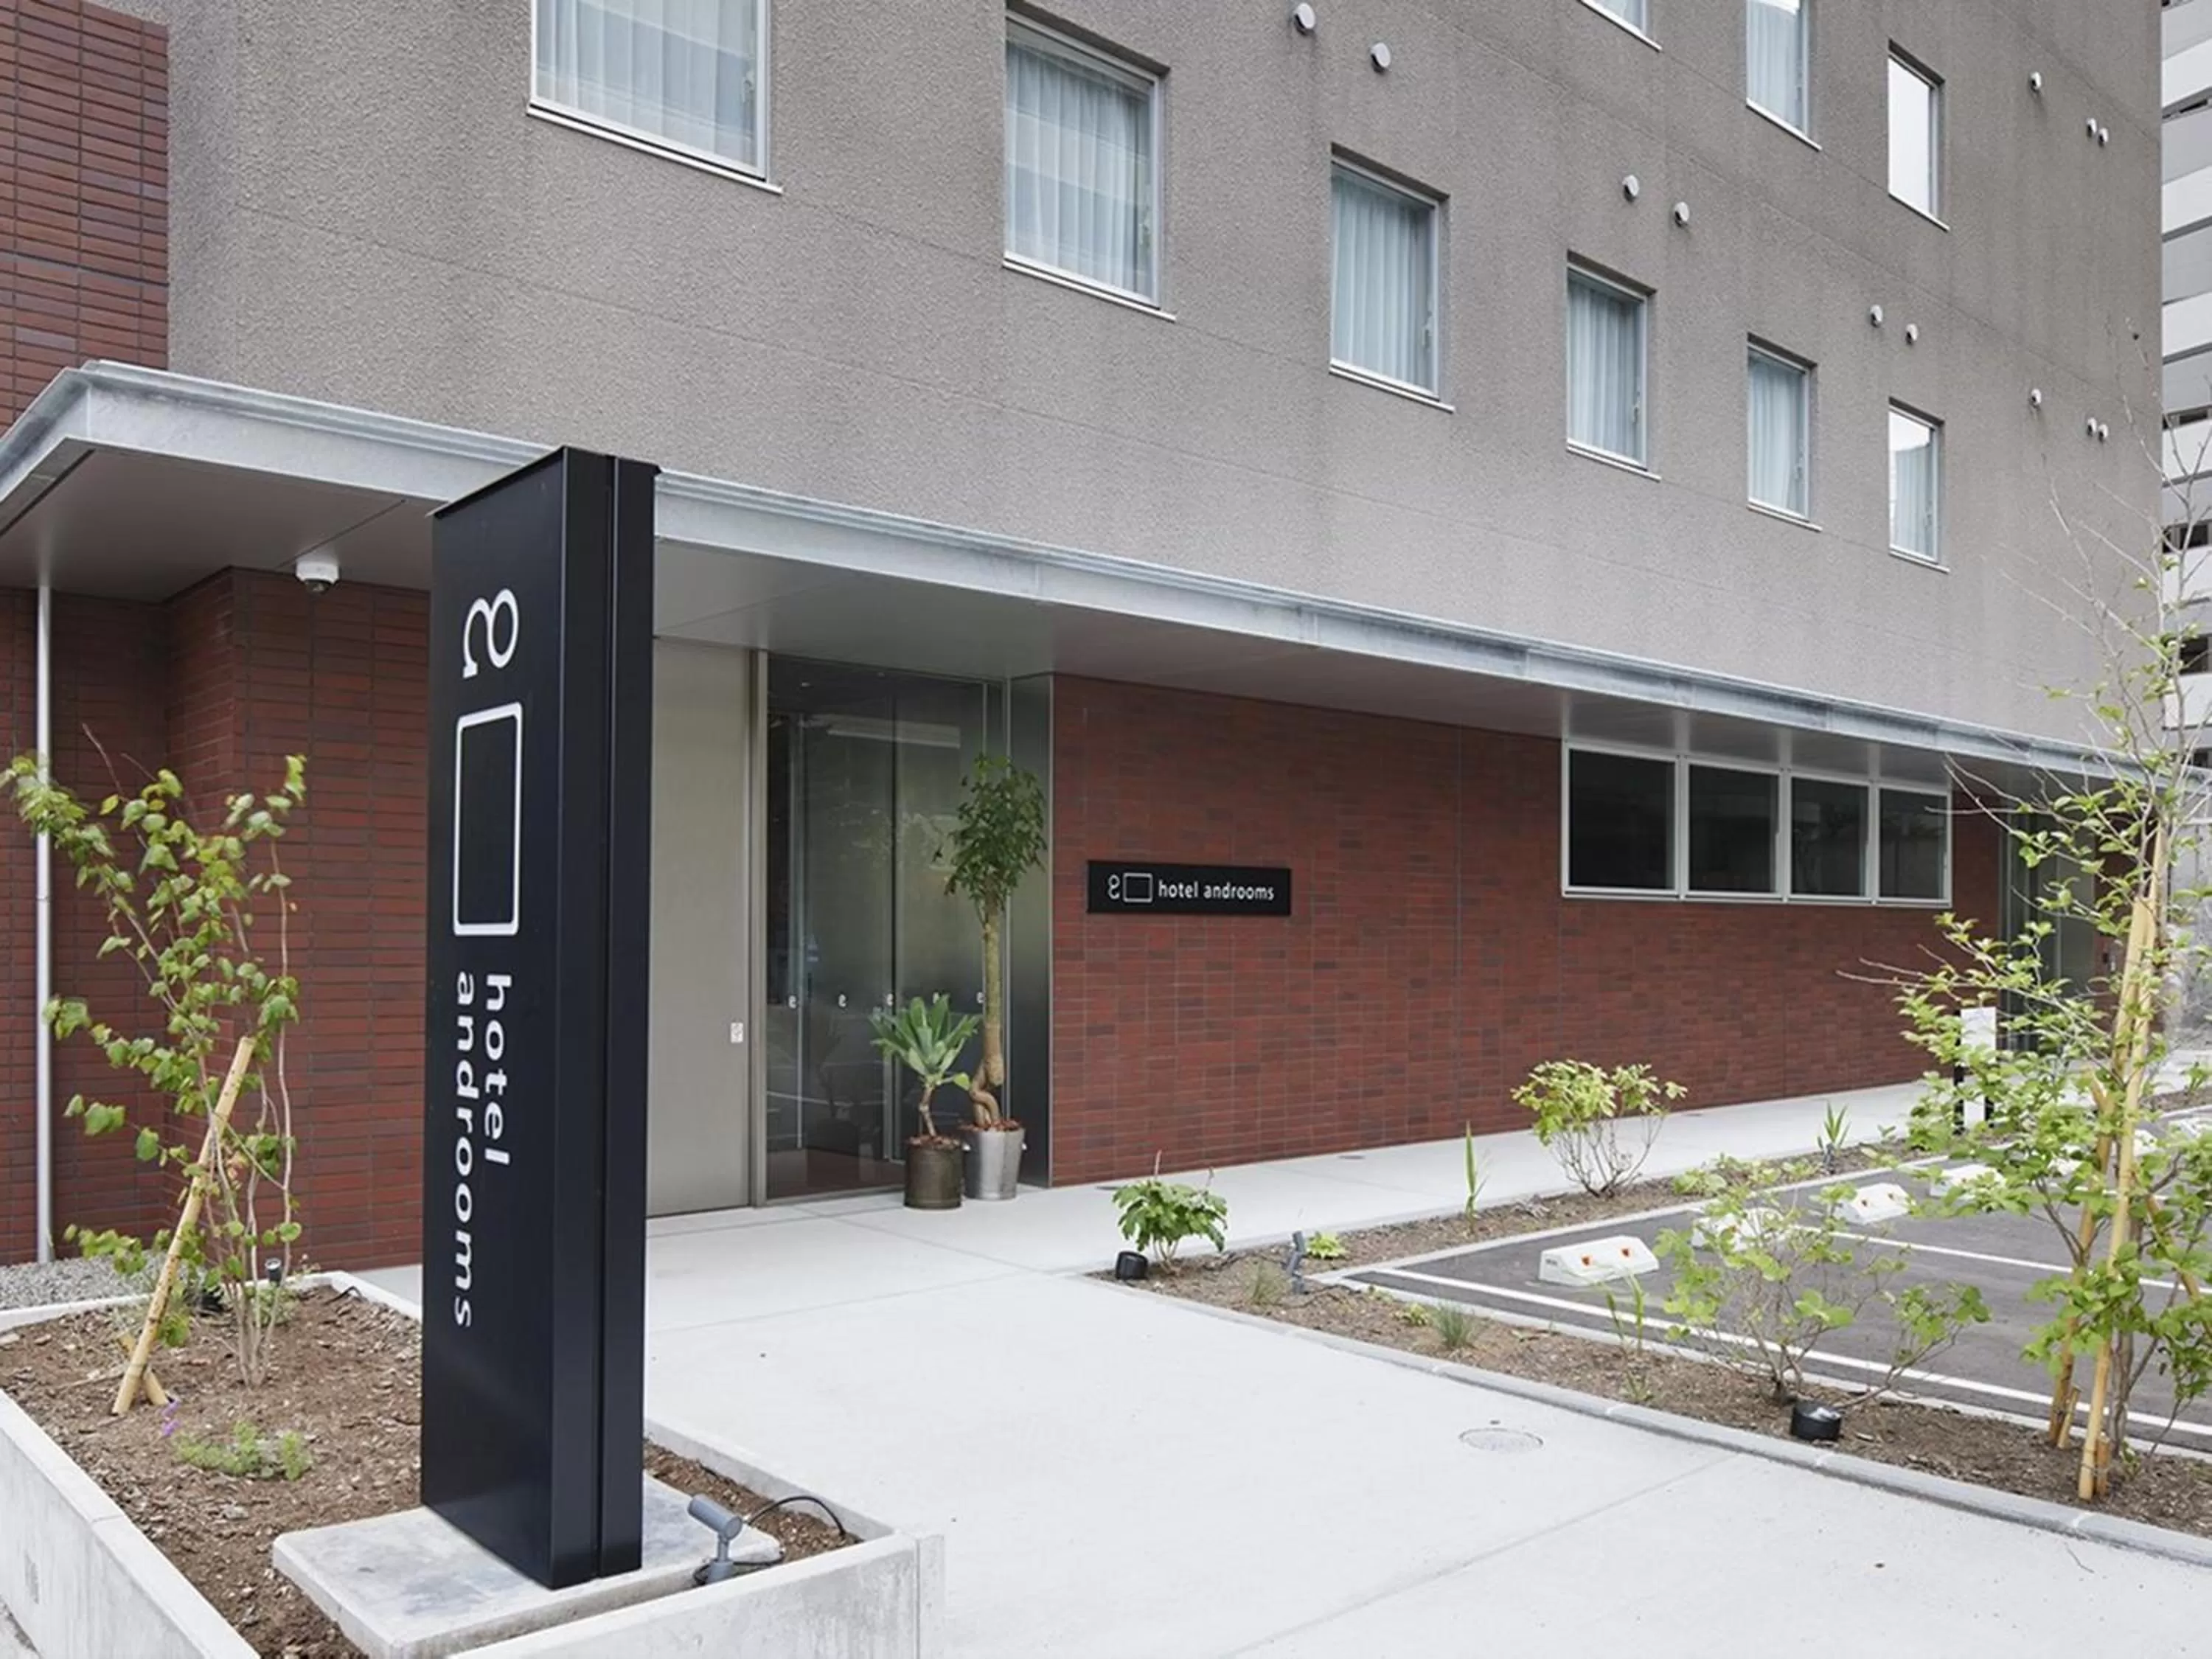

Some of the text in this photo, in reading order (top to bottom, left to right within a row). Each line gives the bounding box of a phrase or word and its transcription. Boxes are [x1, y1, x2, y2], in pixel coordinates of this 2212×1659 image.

[1158, 880, 1274, 900] hotel androoms
[454, 970, 479, 1327] androoms
[484, 973, 512, 1165] hotel
